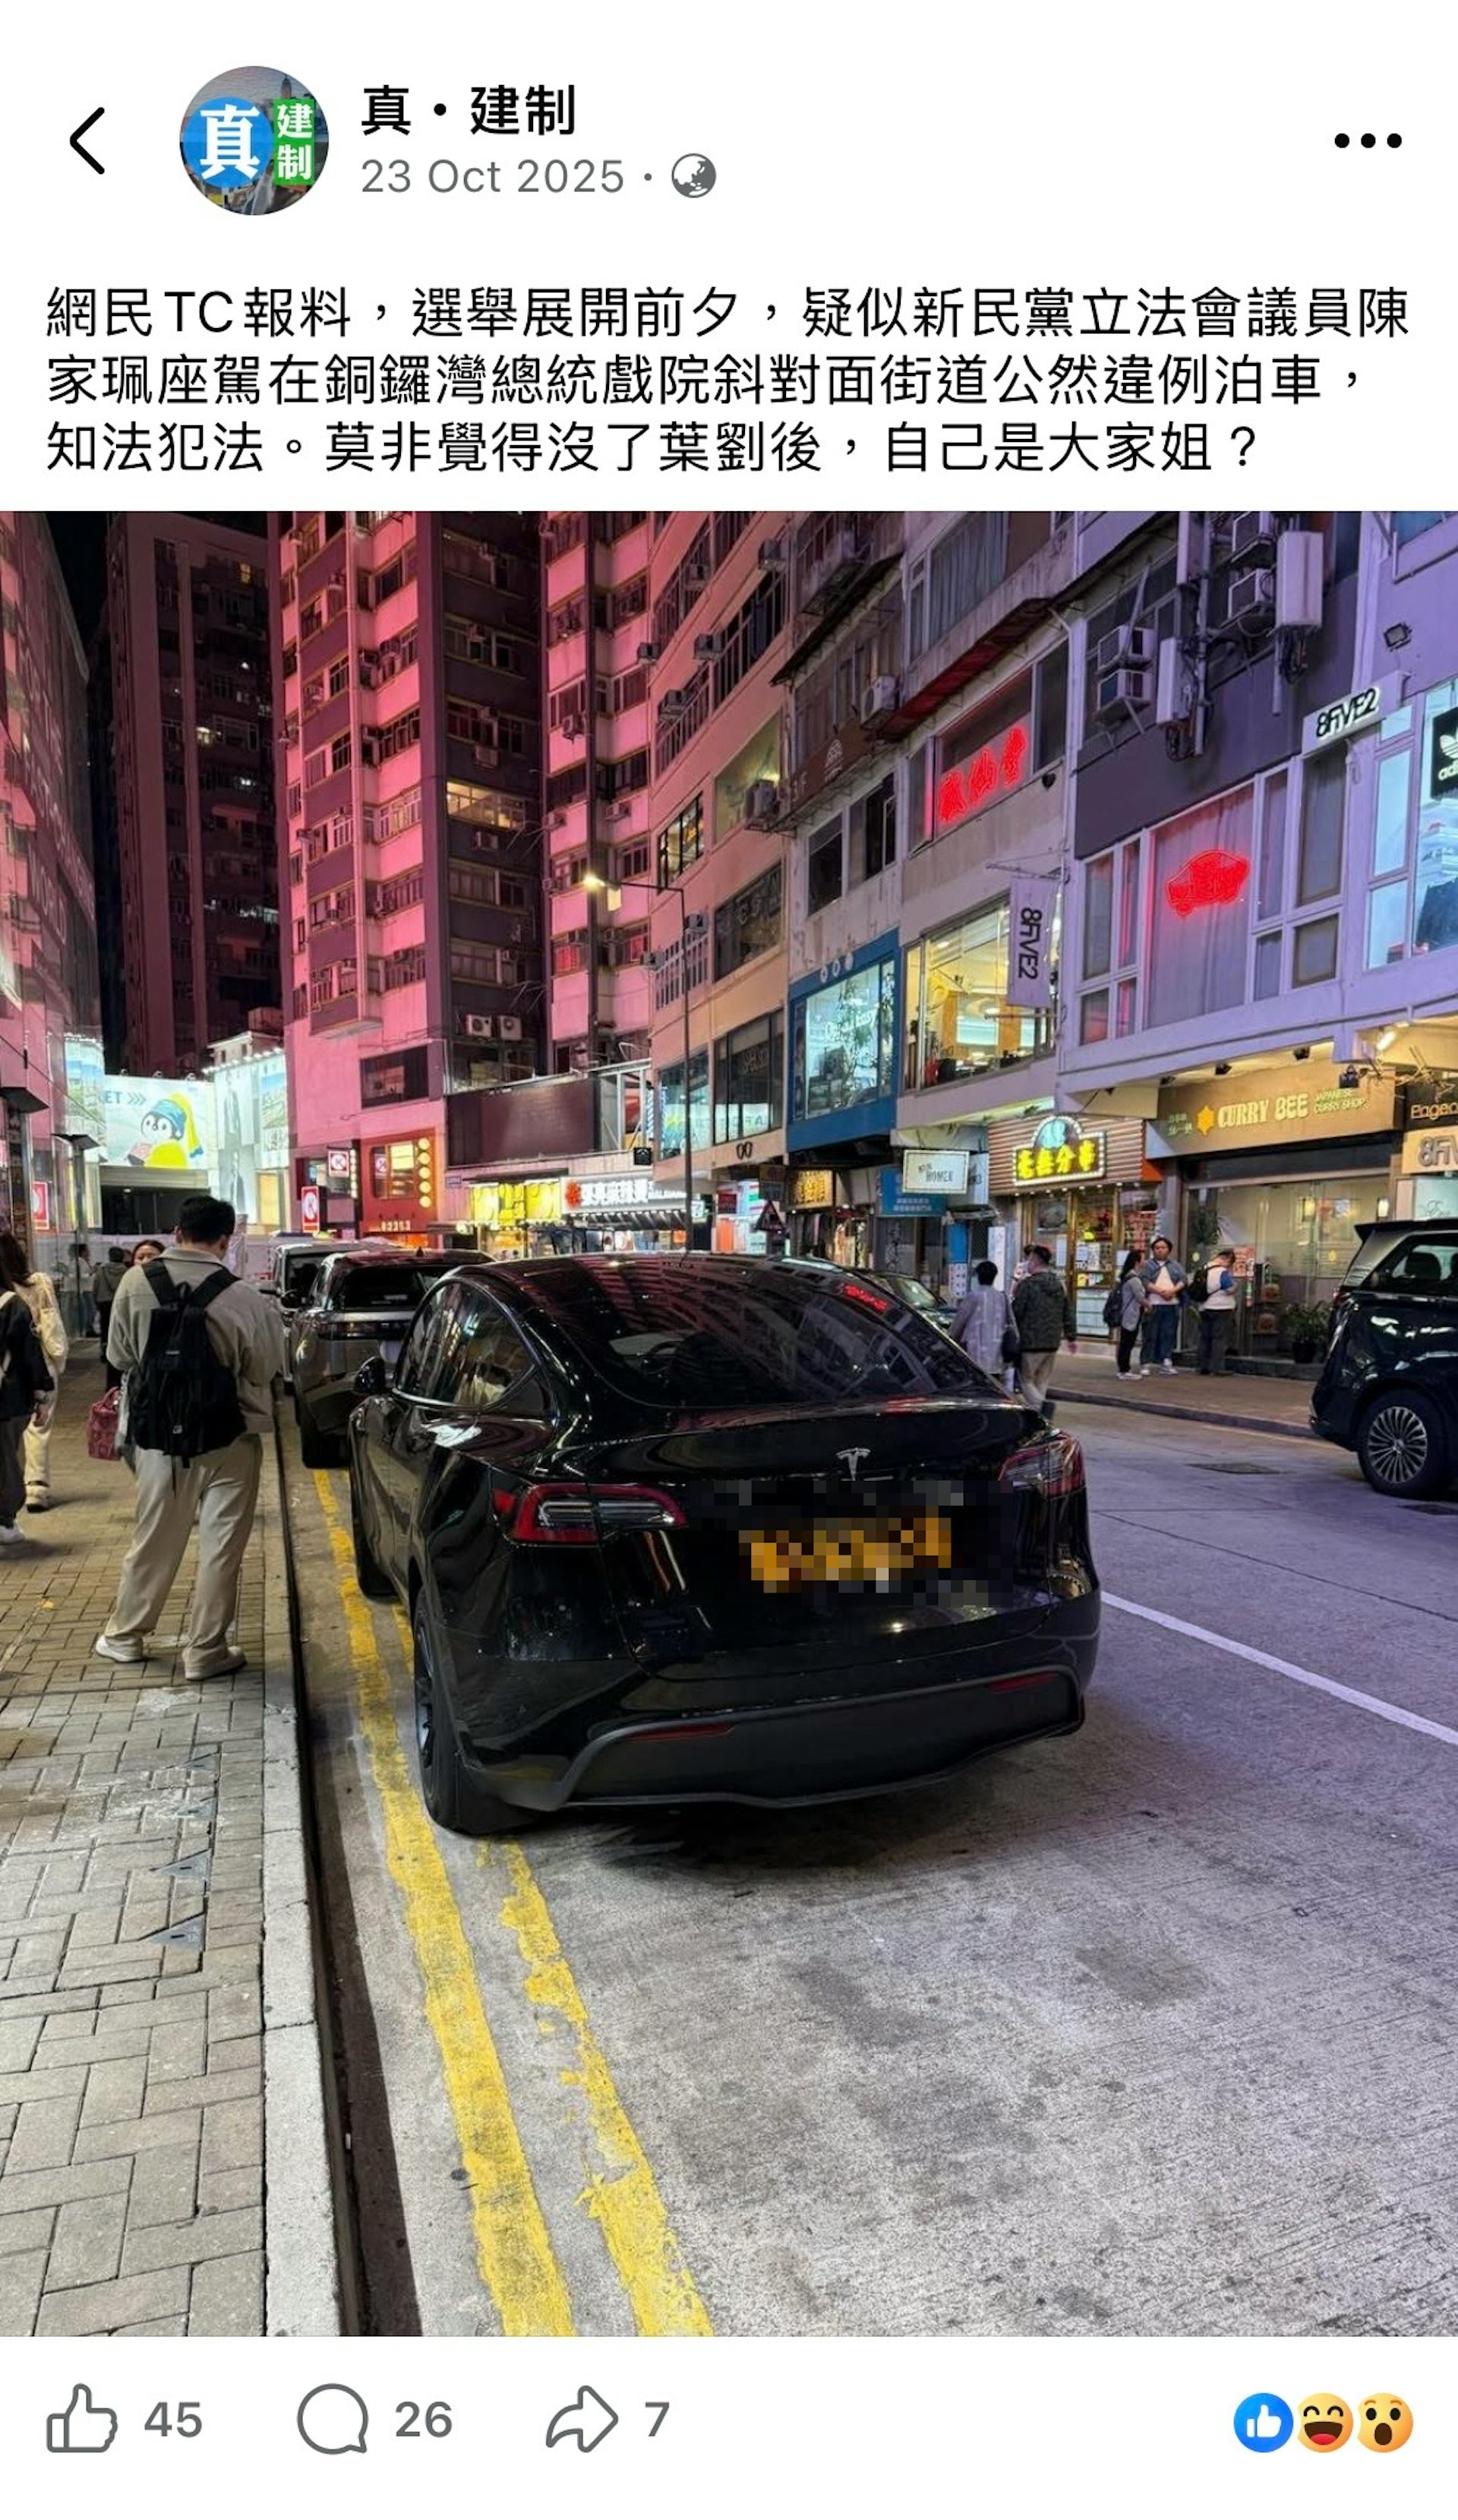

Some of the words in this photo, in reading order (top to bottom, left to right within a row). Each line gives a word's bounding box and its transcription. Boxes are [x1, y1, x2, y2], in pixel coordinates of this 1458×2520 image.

[1316, 687, 1378, 737] 8FIVE2
[1018, 907, 1043, 980] 8FIVE2
[1217, 1100, 1269, 1129] CURRY
[1274, 1093, 1309, 1121] BEE
